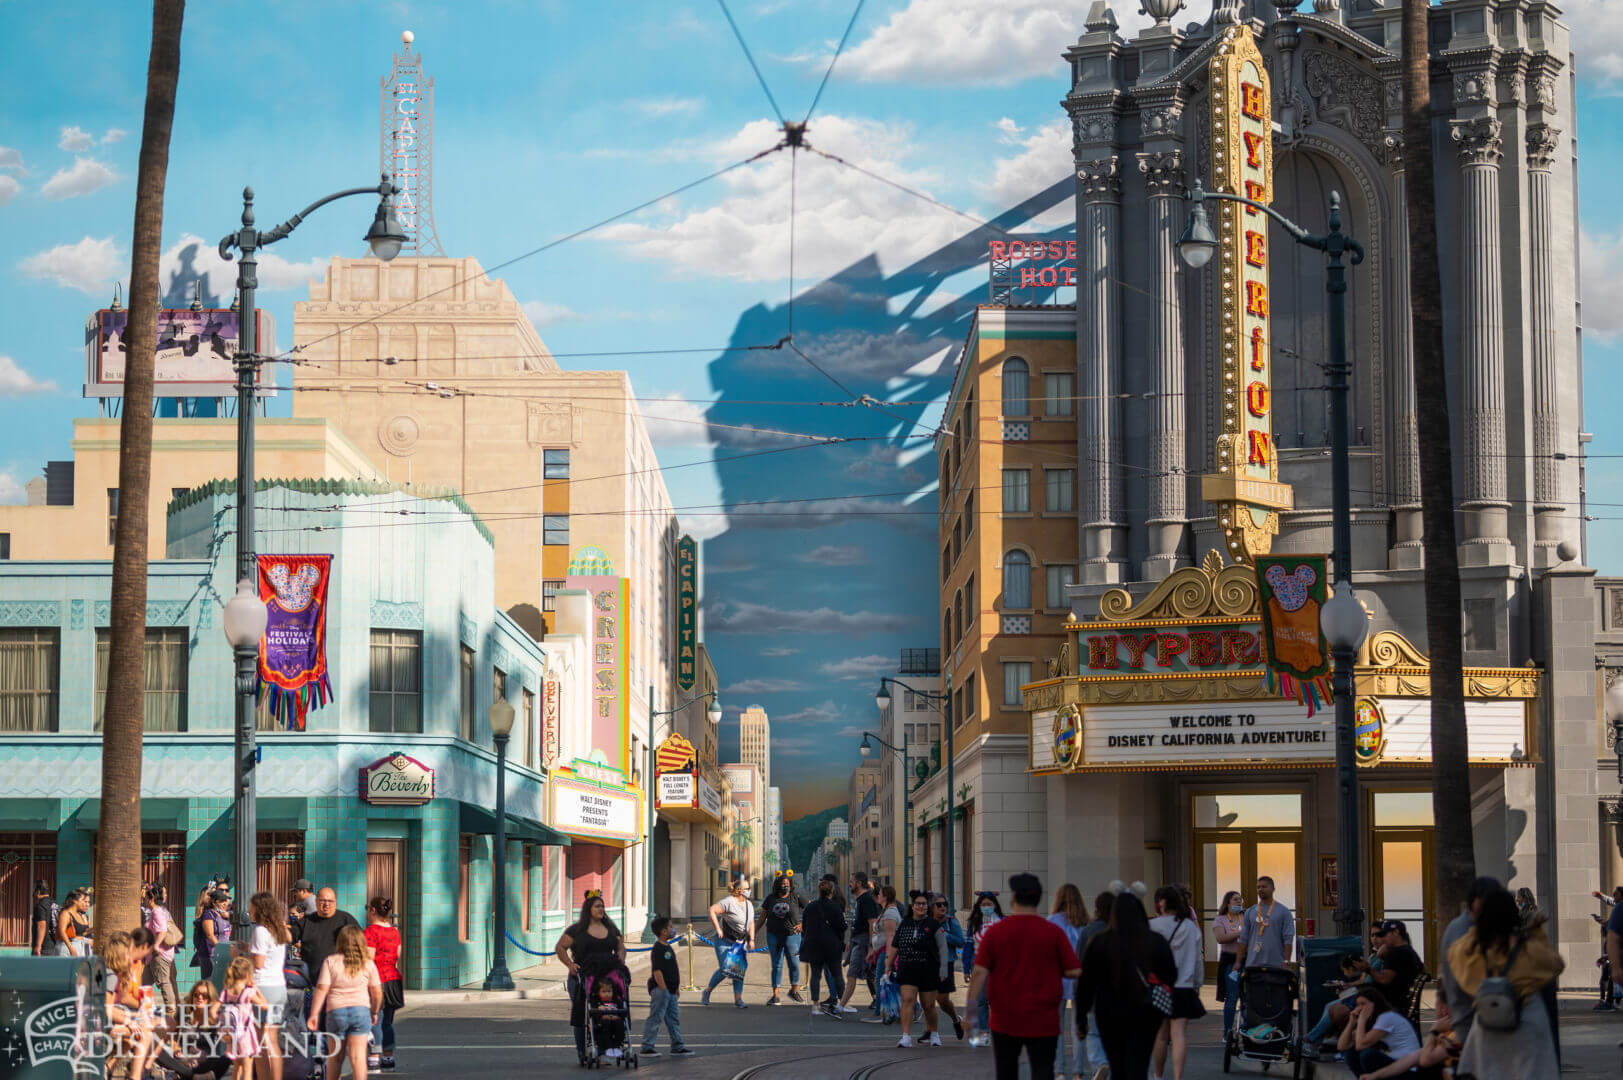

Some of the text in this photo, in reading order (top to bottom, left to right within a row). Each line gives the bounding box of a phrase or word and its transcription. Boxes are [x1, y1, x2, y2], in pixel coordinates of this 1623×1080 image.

[396, 83, 417, 228] EL CAPITAN
[989, 240, 1076, 261] ROOSE
[1020, 266, 1077, 290] HOT
[1241, 81, 1270, 466] HYPERION
[680, 548, 694, 562] EL
[680, 564, 694, 674] CAPITAN
[594, 589, 617, 718] CREST
[545, 680, 557, 767] BEVERLY
[1169, 714, 1256, 728] WELCOME TO
[1108, 730, 1326, 748] DISNEY CALIFORNIA ADVENTURE!
[370, 772, 430, 795] Beverly
[580, 795, 612, 808] WALT DISNEY
[582, 805, 609, 817] PRESENTS
